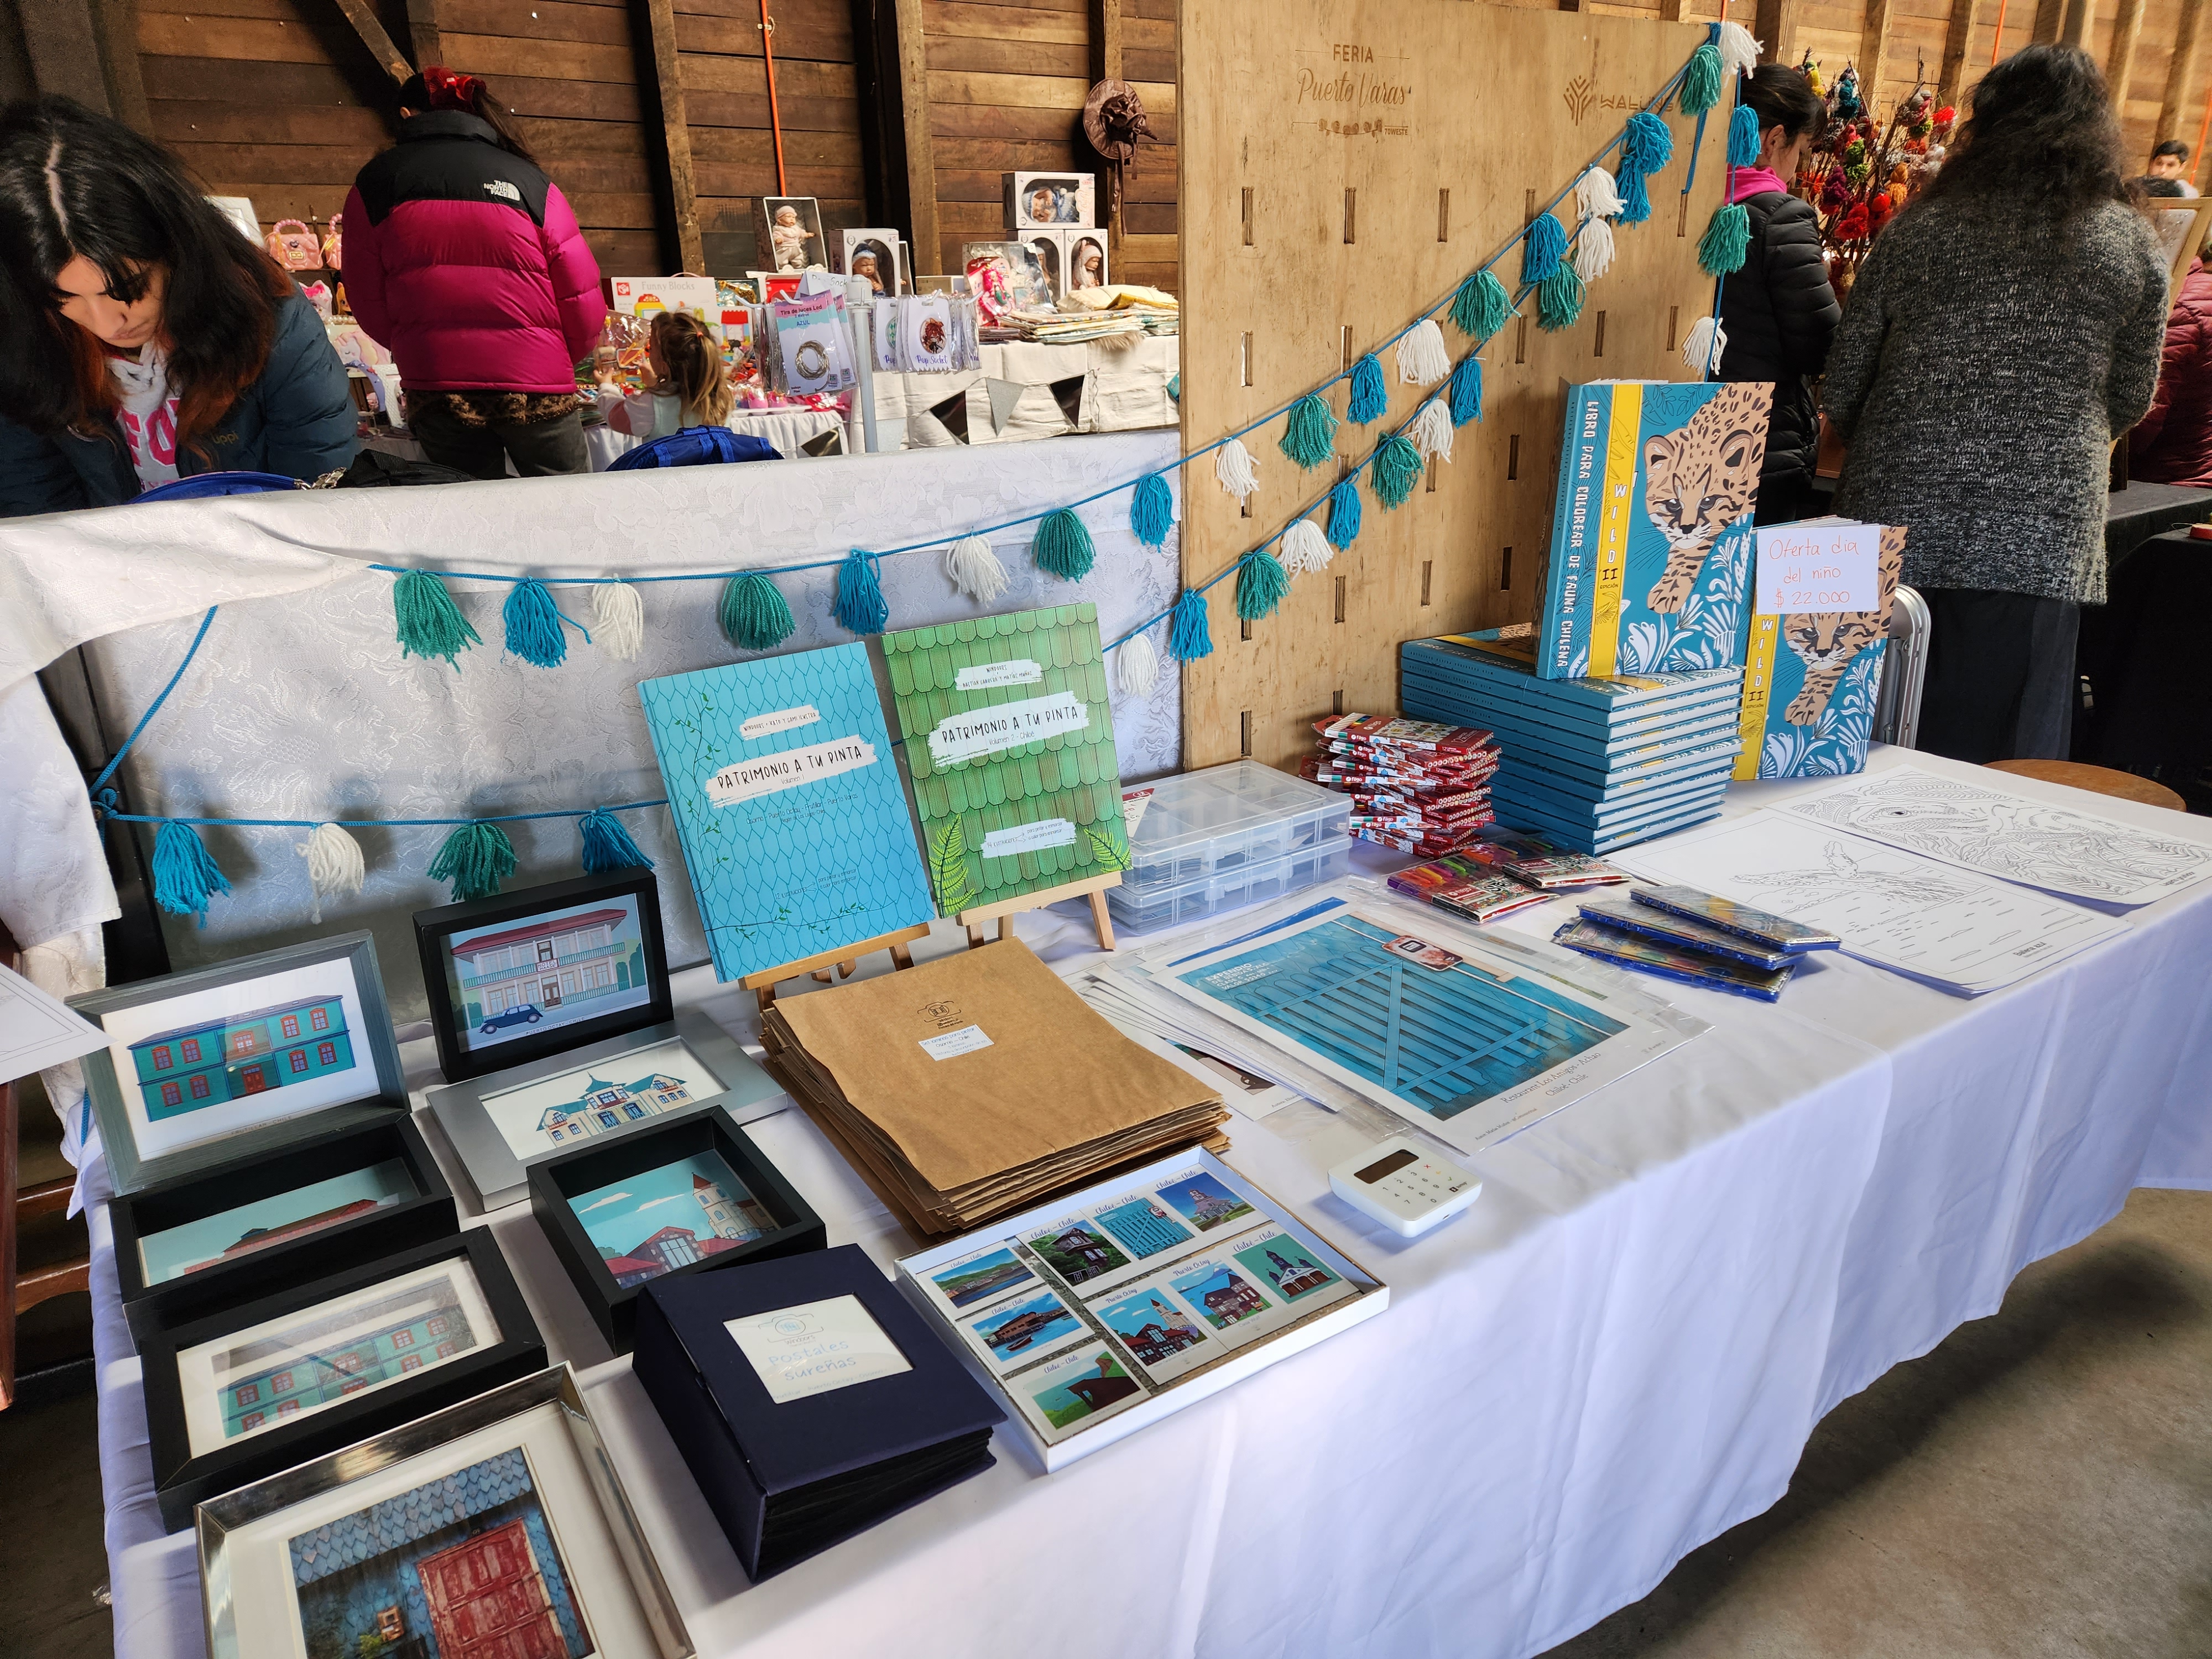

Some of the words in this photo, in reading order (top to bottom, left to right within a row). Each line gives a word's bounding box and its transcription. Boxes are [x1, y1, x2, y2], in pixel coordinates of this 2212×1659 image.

[1333, 44, 1373, 63] FERIA
[1297, 68, 1354, 105] Puerto
[1359, 72, 1405, 108] Varas
[484, 183, 508, 192] NORTH
[641, 281, 667, 291] Funny
[669, 281, 695, 290] Blocks
[830, 277, 847, 287] Sock
[916, 354, 928, 365] Pop
[1583, 400, 1599, 438] LIBRO
[1578, 446, 1594, 479] PARA
[1571, 486, 1589, 549] COLOREAR
[1770, 538, 1820, 560] Oferta
[1832, 535, 1859, 555] dia
[1568, 555, 1581, 569] DE
[1603, 568, 1618, 581] II
[1783, 566, 1801, 584] del
[1813, 566, 1841, 578] niño
[1563, 575, 1578, 614] FAUNA
[1792, 591, 1850, 605] 22.000
[1557, 620, 1573, 667] CHILENA
[1749, 691, 1764, 701] II
[942, 719, 1008, 743] PATRIMONIO
[1013, 717, 1020, 730] A
[1025, 713, 1041, 727] TU
[1046, 706, 1078, 723] PINTA
[989, 737, 1009, 745] Volumen
[717, 762, 789, 789] PATRIMONIO
[795, 759, 802, 773] A
[807, 755, 823, 769] TU
[828, 745, 862, 764] PINTA
[781, 776, 801, 785] Volumen
[747, 816, 764, 825] Osorno
[768, 810, 785, 819] Puerto
[786, 807, 800, 816] Octay
[827, 796, 843, 805] Puerto
[844, 794, 858, 802] Varas
[1206, 963, 1252, 981] EXPENDIO
[526, 1027, 547, 1035] PUERTO
[1500, 1083, 1541, 1104] Restaurant
[1536, 1077, 1553, 1087] Los
[1552, 1064, 1577, 1080] Amigos
[1578, 1052, 1601, 1066] Achao
[1546, 1083, 1568, 1097] Chiloé
[1569, 1073, 1589, 1084] Chile
[231, 1123, 267, 1134] FRUTILLAR
[273, 1115, 292, 1124] CHILE
[1181, 1170, 1198, 1180] Chile
[1121, 1194, 1139, 1205] Chile
[1058, 1217, 1077, 1229] Chile
[1259, 1231, 1277, 1242] Chile
[769, 1340, 849, 1366] Postales
[785, 1357, 857, 1381] sureñas
